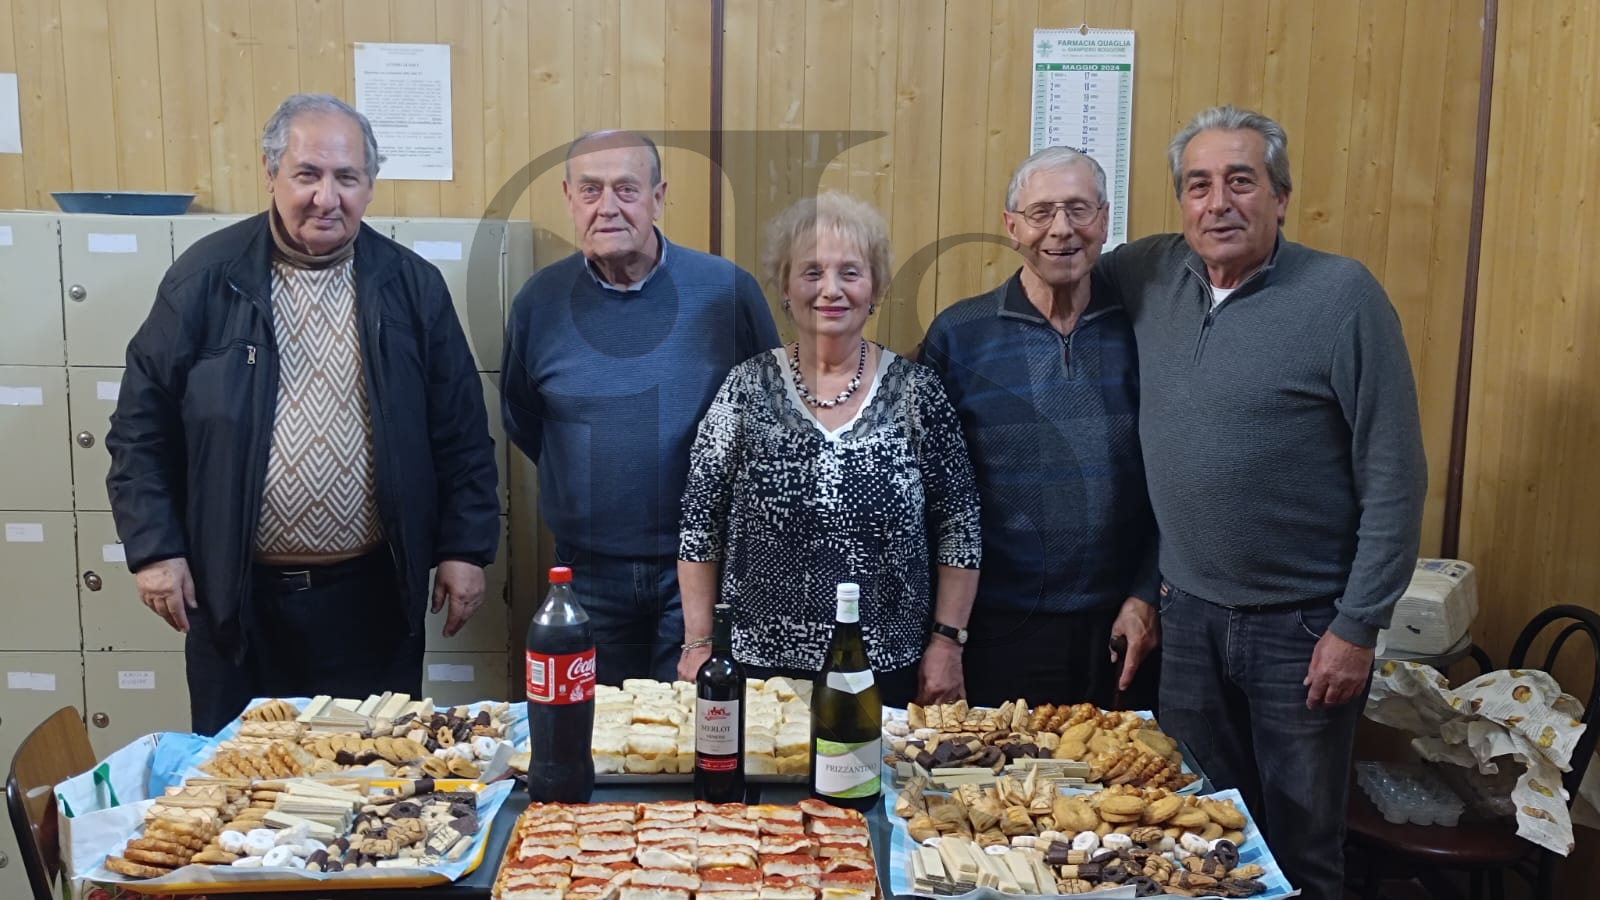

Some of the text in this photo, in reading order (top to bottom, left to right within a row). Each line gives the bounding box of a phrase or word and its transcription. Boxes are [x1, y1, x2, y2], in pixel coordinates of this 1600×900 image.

[1057, 39, 1131, 47] FARMACIA QUAGLIA
[701, 724, 731, 733] MERLOT
[825, 762, 877, 774] FRIZZANTINO
